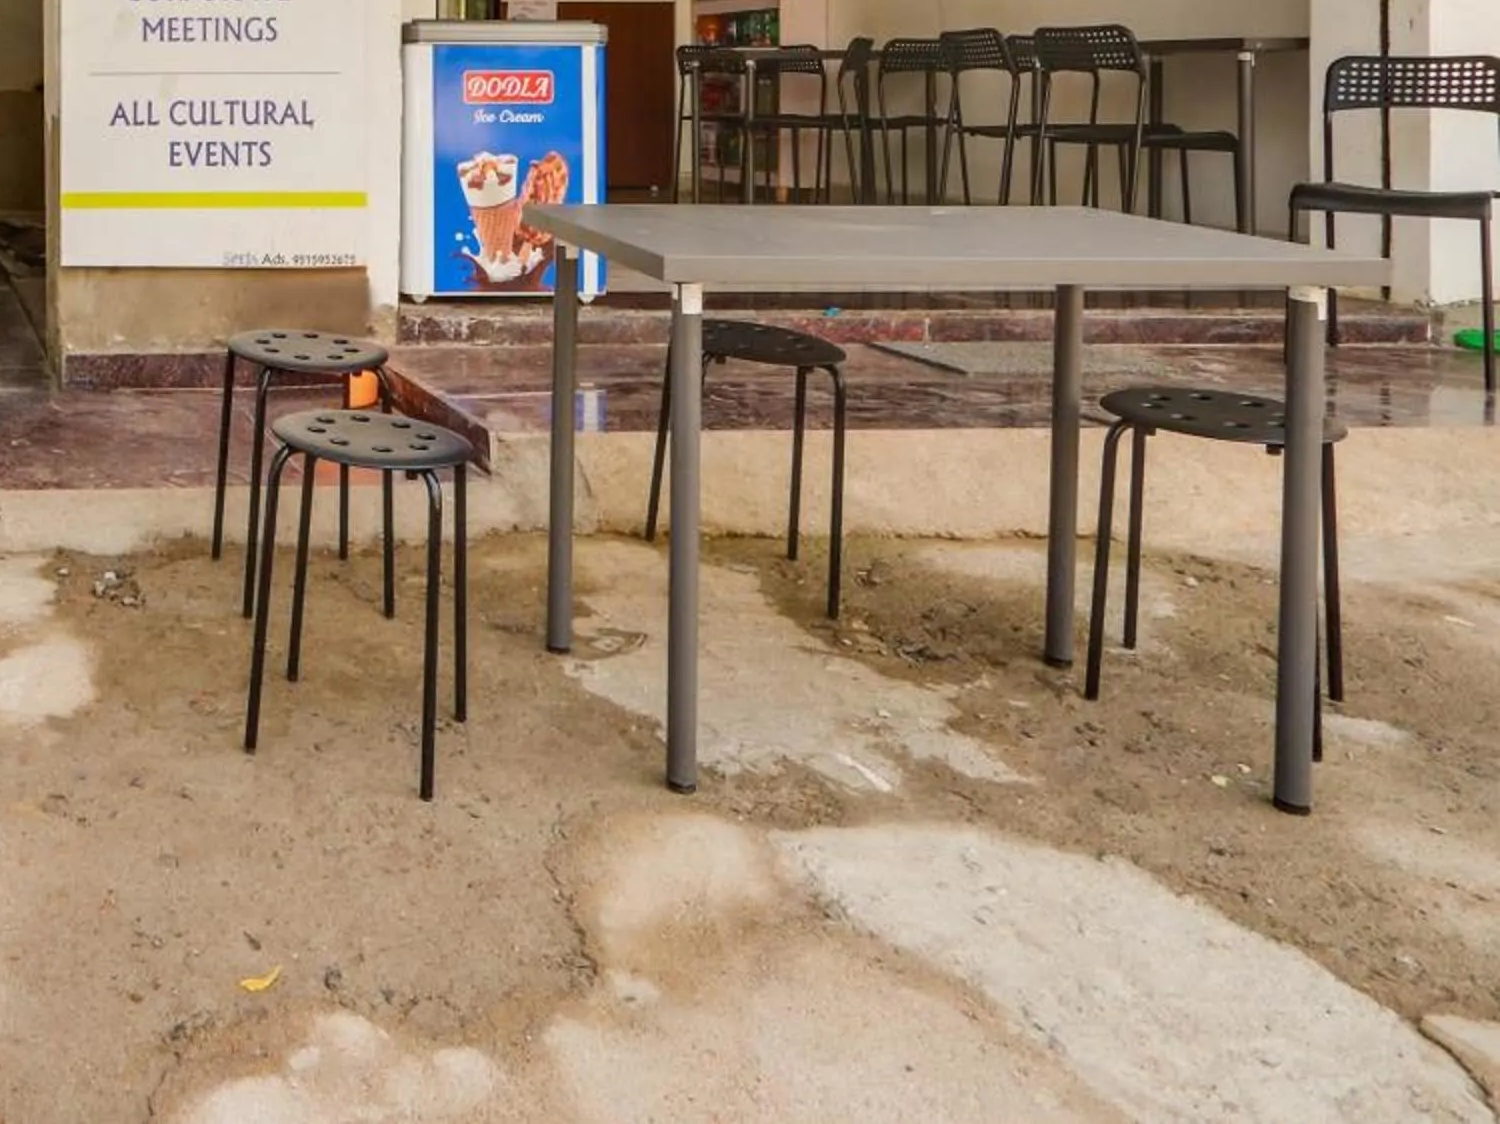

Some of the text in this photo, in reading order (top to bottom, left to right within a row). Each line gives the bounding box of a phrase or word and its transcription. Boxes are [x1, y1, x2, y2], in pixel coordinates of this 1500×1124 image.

[141, 17, 279, 43] MEETINGS
[467, 76, 549, 97] DODLA
[108, 100, 316, 129] ALL CULTURAL
[474, 108, 545, 123] Ice Cream
[167, 141, 273, 168] EVENTS
